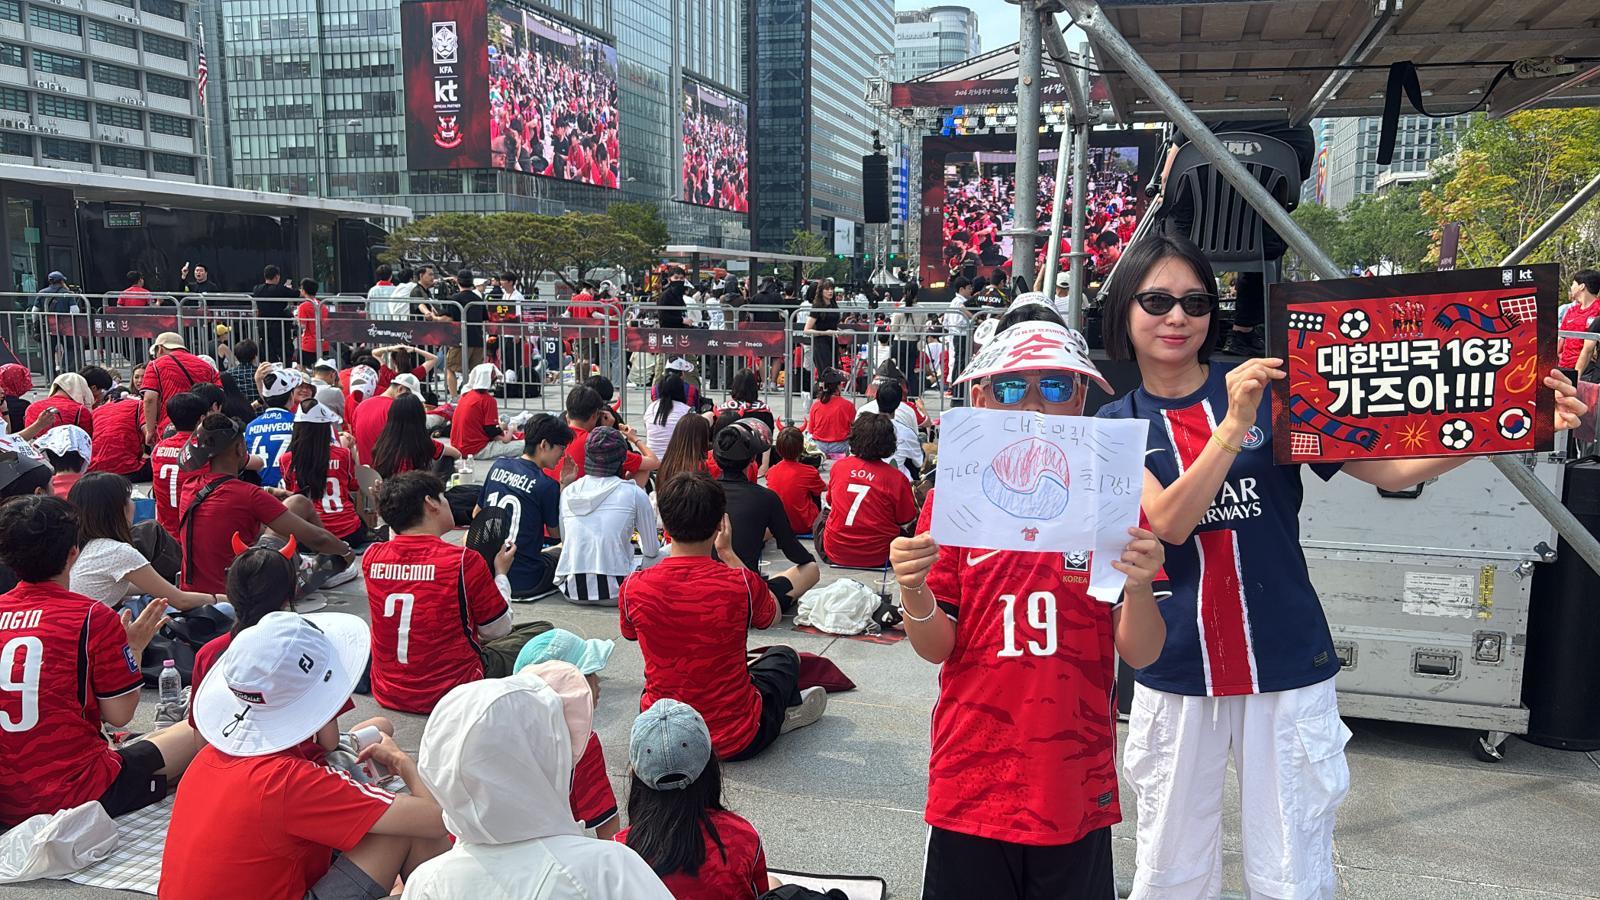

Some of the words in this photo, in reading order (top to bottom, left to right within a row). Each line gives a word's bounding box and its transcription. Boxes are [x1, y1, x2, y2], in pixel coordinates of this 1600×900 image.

[439, 66, 453, 74] KFA
[435, 80, 458, 102] kt
[1519, 270, 1532, 279] kt
[106, 320, 115, 329] kt
[545, 342, 556, 353] 19
[662, 335, 673, 345] kt
[1318, 339, 1441, 375] 대한민국
[1446, 338, 1511, 367] 16강
[1327, 372, 1495, 415] 가즈아!!!
[249, 423, 295, 435] MINHYEOK
[251, 434, 293, 468] 47
[159, 464, 180, 508] 7
[490, 468, 536, 494] O.DEMBÉLÉ
[850, 469, 875, 482] SON
[1211, 477, 1260, 508] AR
[845, 483, 871, 527] 7
[1199, 501, 1262, 525] IRWAYS
[486, 491, 521, 548] 0
[370, 563, 436, 581] HEUNGMIN
[1062, 575, 1088, 584] KOREA
[383, 593, 415, 665] 7
[996, 591, 1058, 658] 19
[298, 653, 314, 674] FJ
[0, 636, 44, 732] 9
